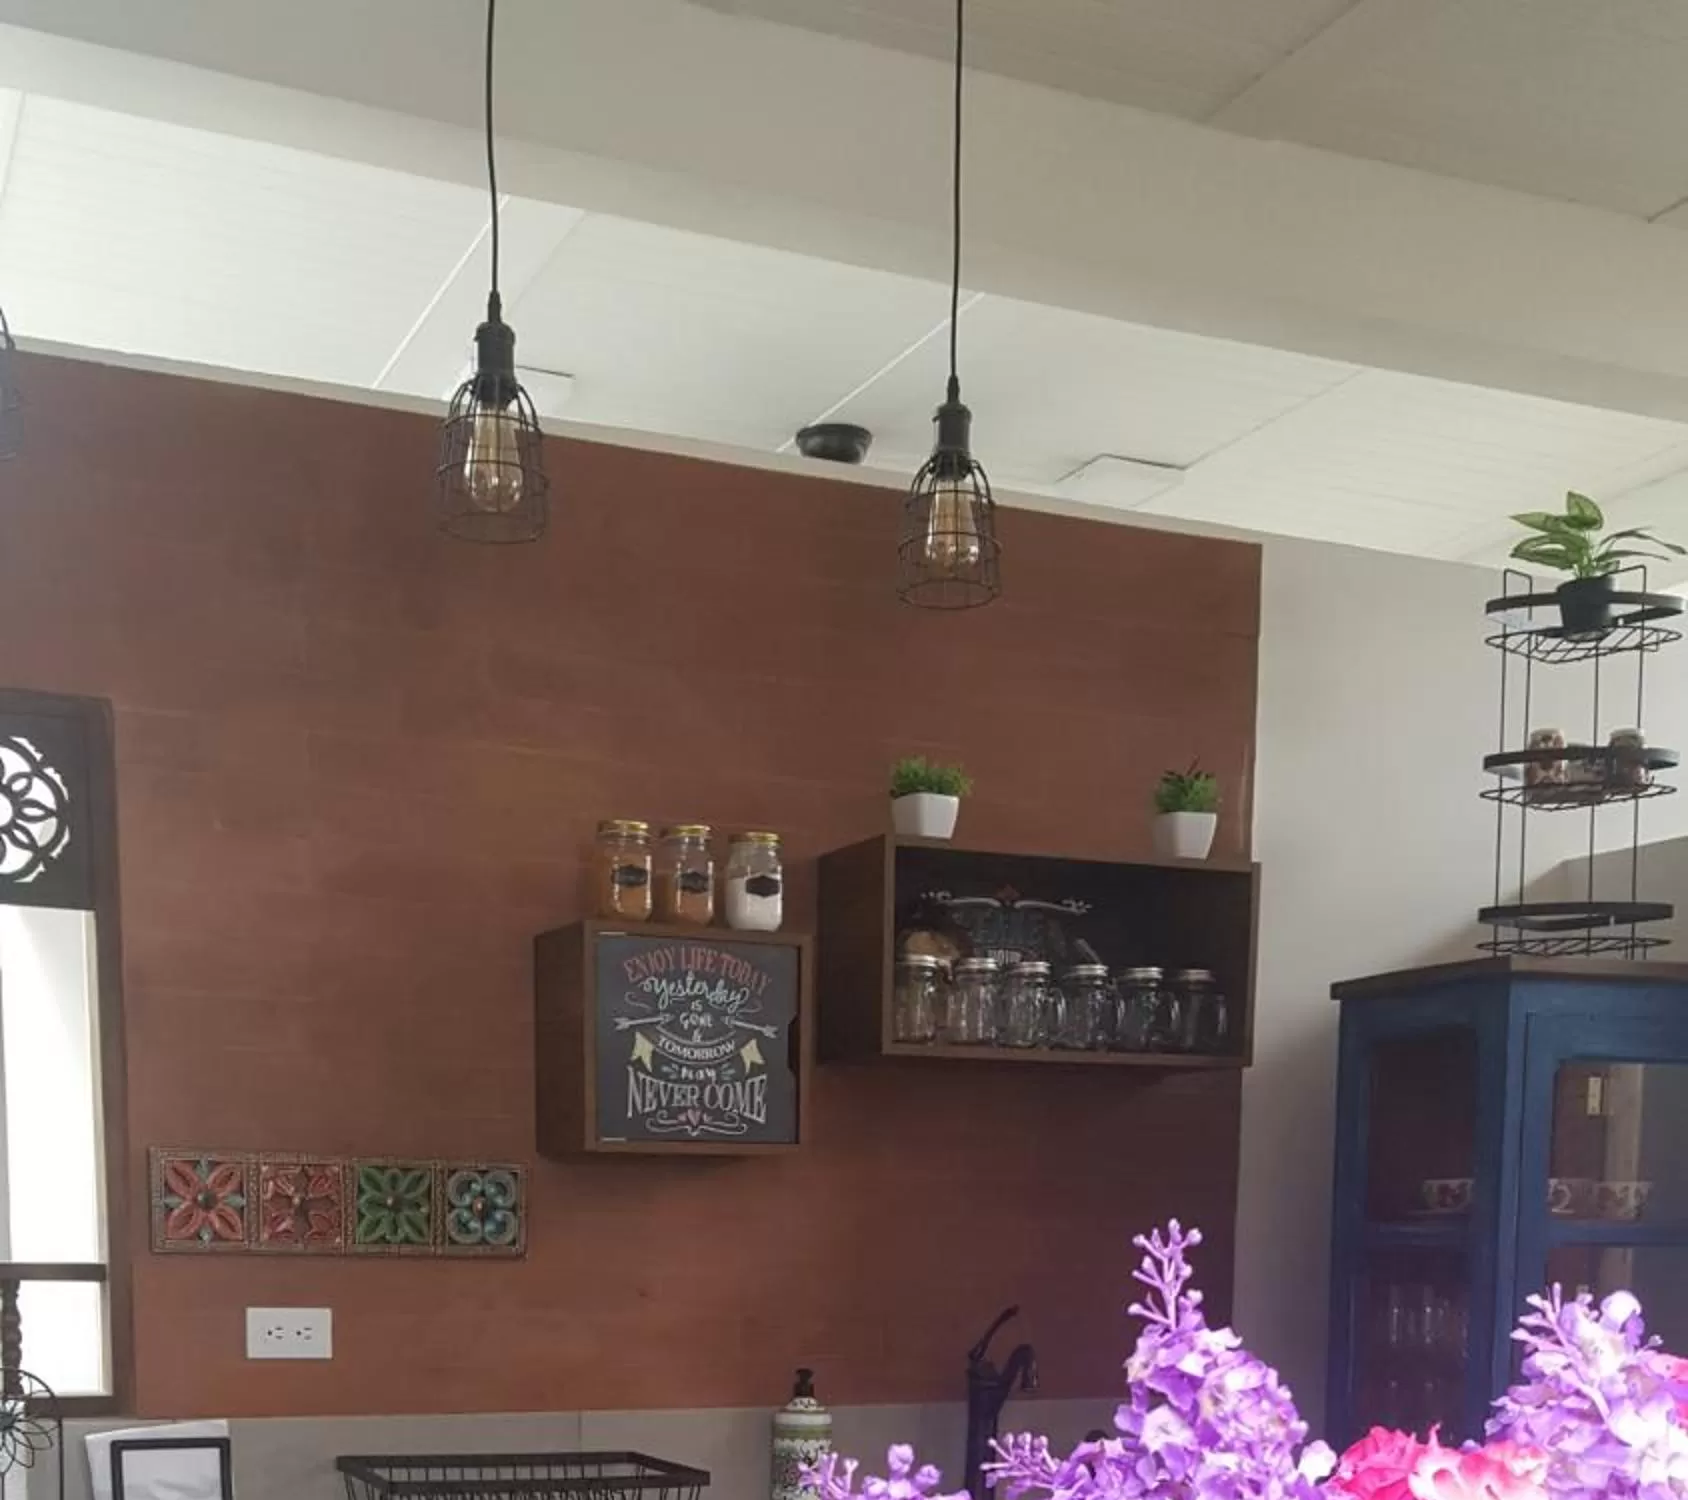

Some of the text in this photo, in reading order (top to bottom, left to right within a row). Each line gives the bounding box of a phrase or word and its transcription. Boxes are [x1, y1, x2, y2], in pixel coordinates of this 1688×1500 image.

[624, 946, 773, 996] ENJOY LIFE TODAY
[657, 1037, 735, 1060] TOMORROW
[627, 1066, 767, 1123] NEVER COME
